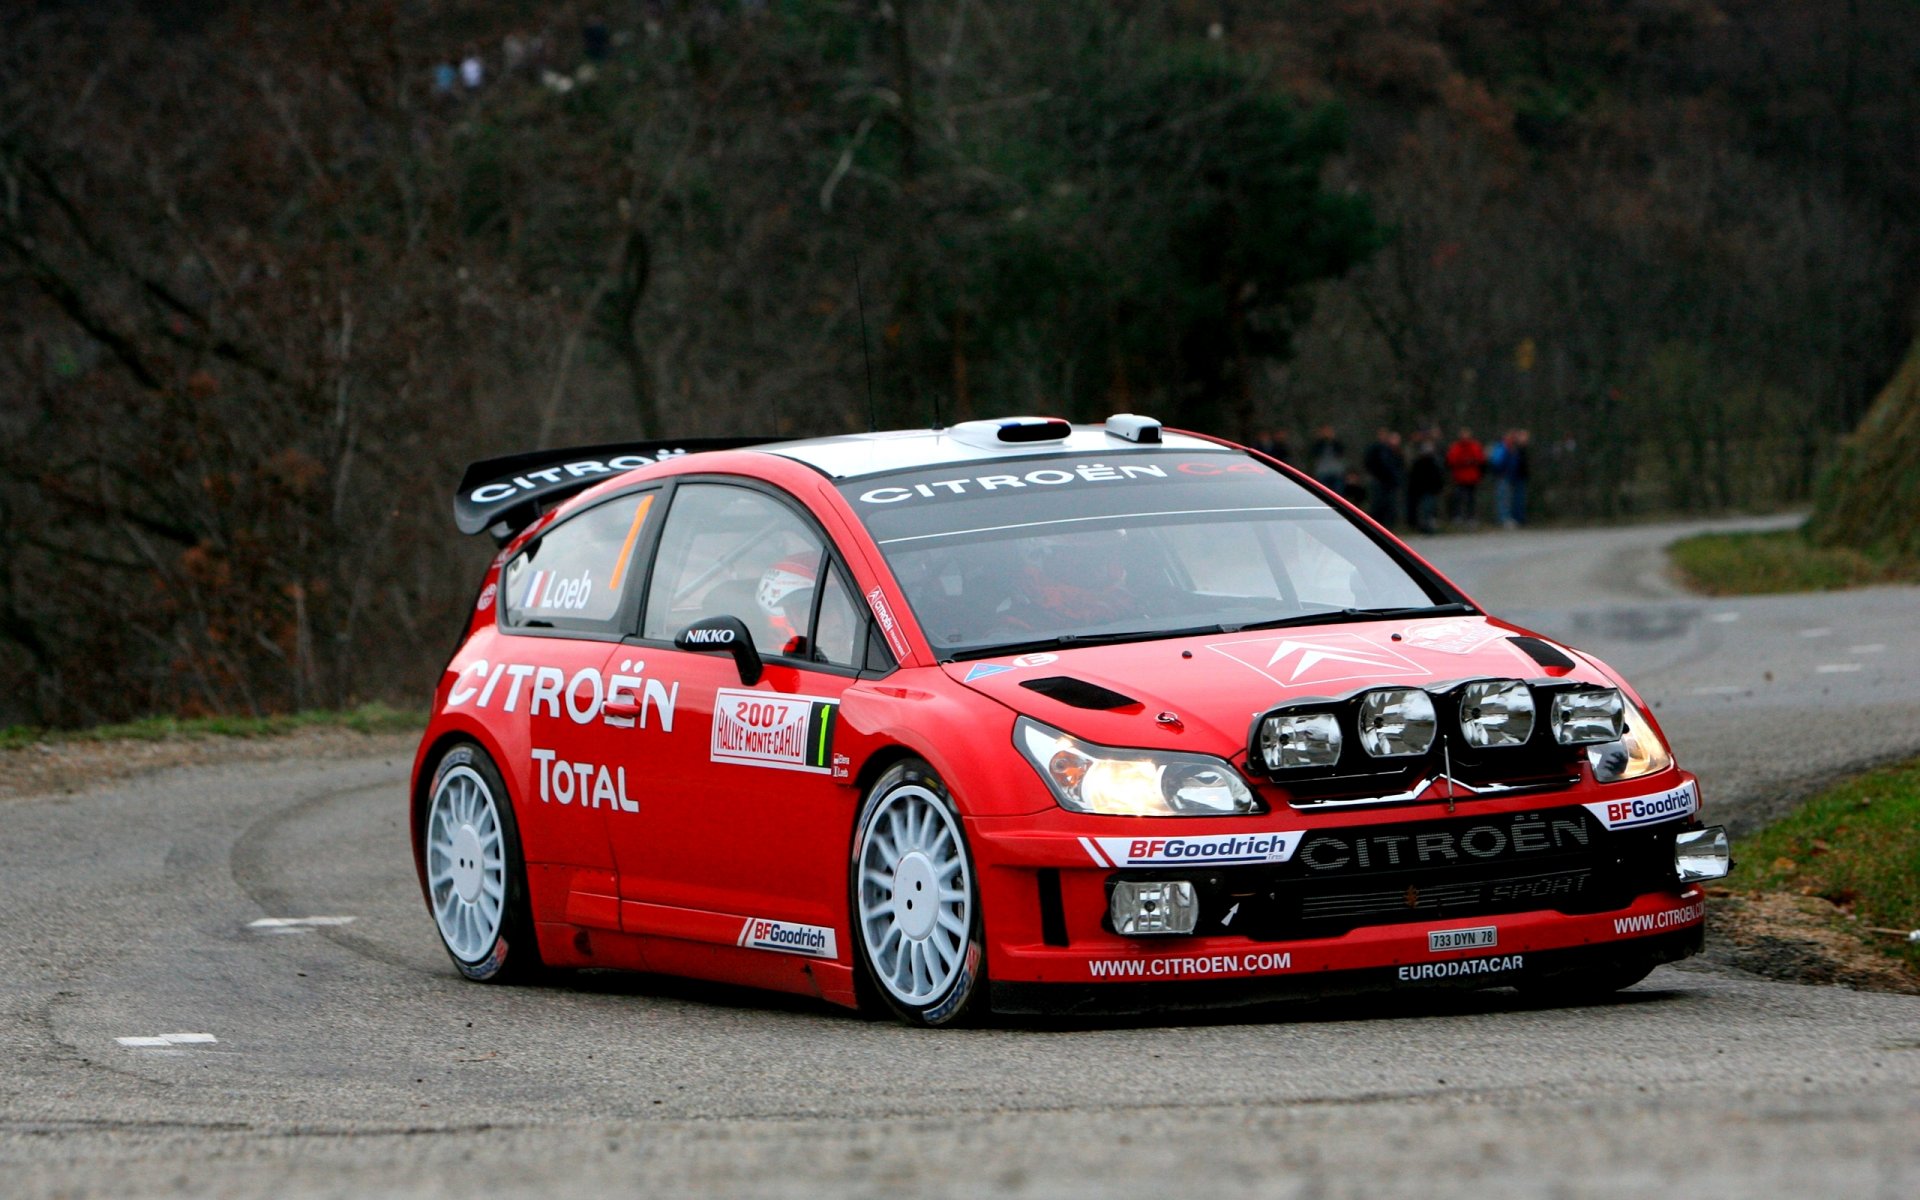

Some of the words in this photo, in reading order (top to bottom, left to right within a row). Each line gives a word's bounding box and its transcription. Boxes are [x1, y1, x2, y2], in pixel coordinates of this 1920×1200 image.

[859, 463, 1168, 504] CITROËN
[1177, 463, 1267, 477] C4
[541, 550, 592, 609] Loeb
[685, 629, 735, 643] NIKKO
[447, 659, 679, 733] CITROËN
[735, 701, 789, 728] 2007
[717, 707, 744, 751] RALLYE
[745, 715, 804, 757] MONTE-CARLO
[816, 704, 831, 766] 1
[1607, 789, 1692, 822] BFGoodrich
[1128, 835, 1286, 858] BFGoodrich
[1300, 814, 1590, 870] CITROËN
[1491, 873, 1591, 901] SPORT
[754, 921, 826, 948] BFGoodrich
[1433, 935, 1451, 948] 733
[1454, 932, 1476, 946] DYN
[1481, 931, 1493, 943] 78
[1089, 952, 1291, 977] WWW.CITROEN.COM
[1399, 955, 1523, 980] EURODATACAR
